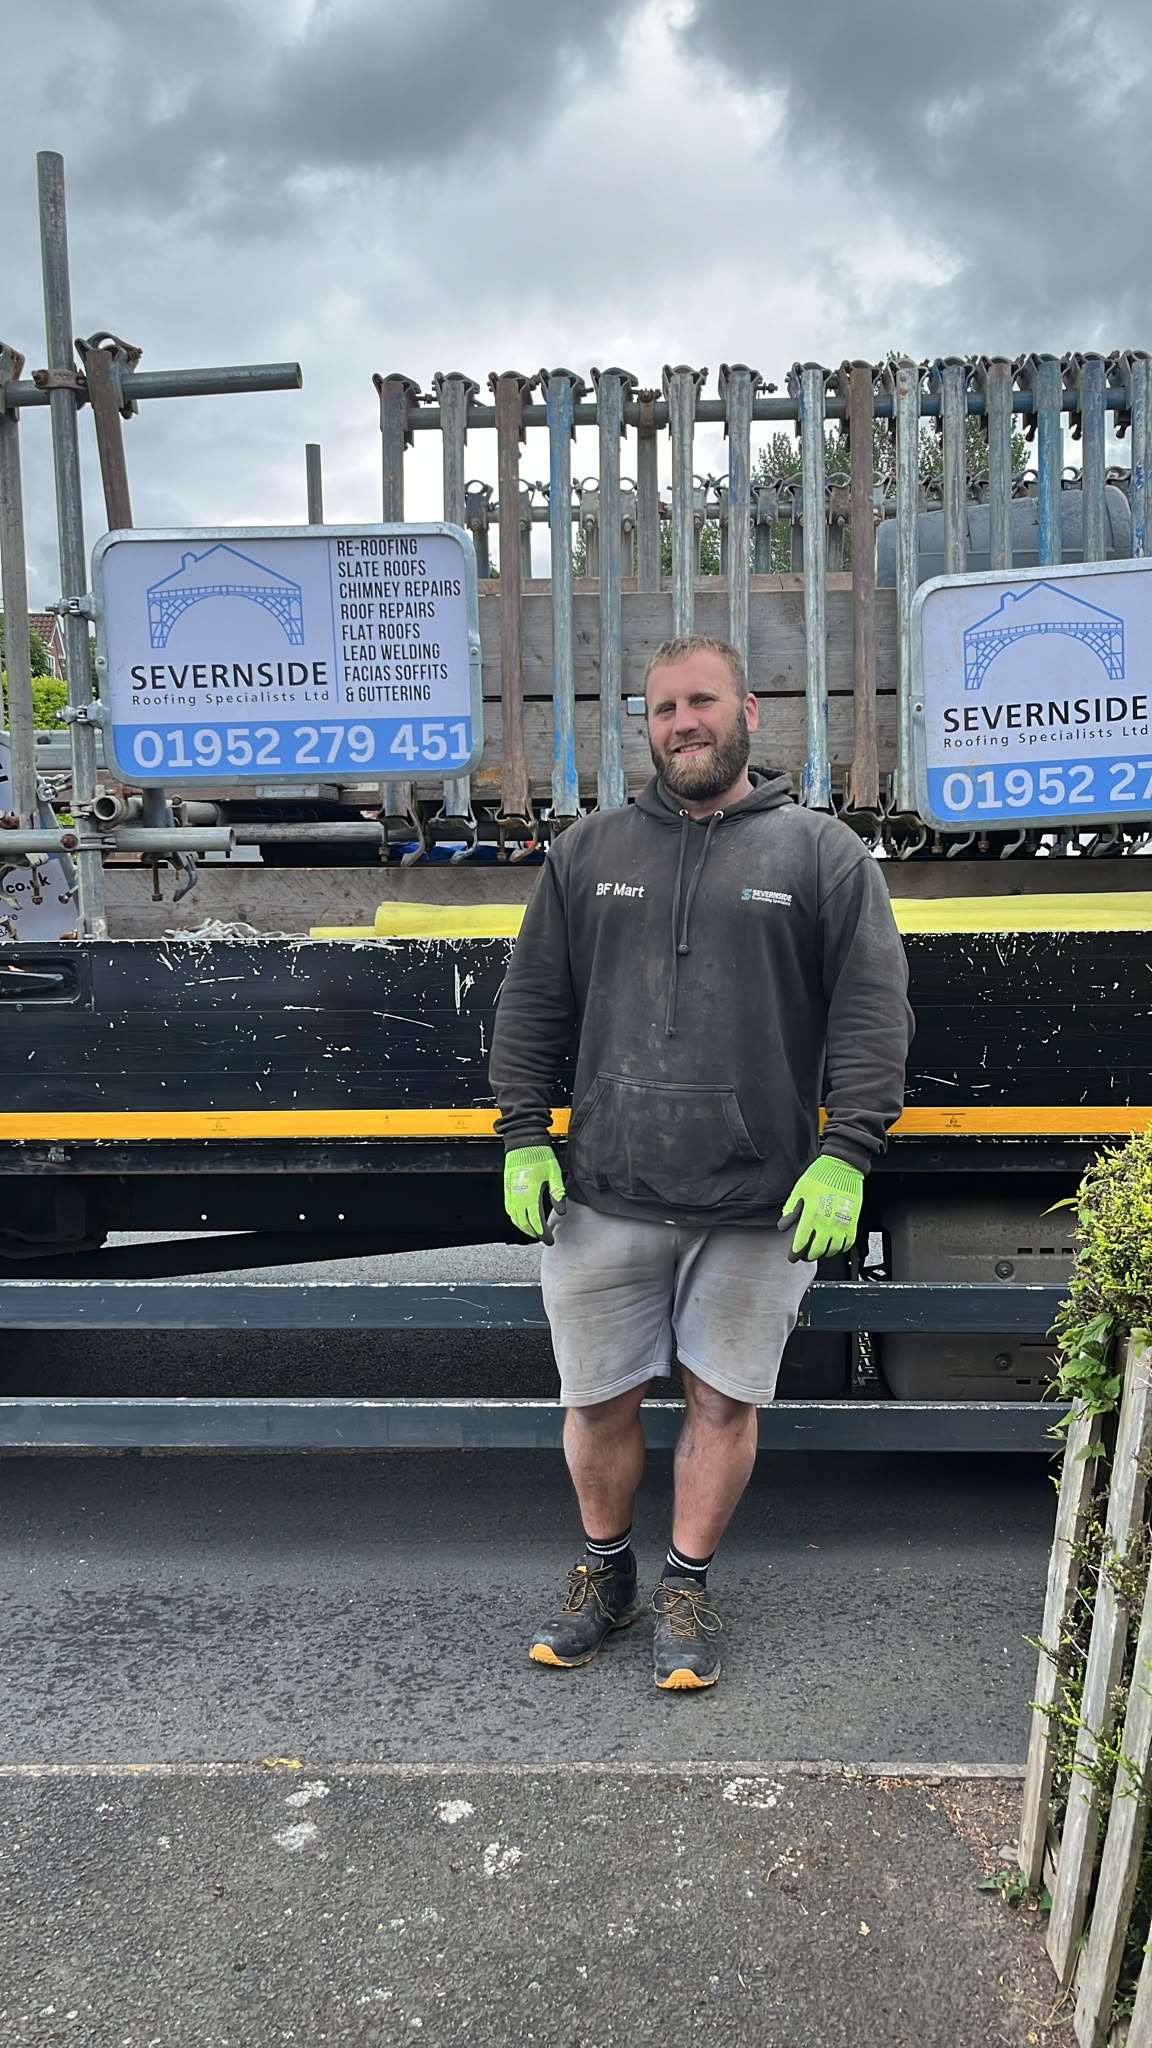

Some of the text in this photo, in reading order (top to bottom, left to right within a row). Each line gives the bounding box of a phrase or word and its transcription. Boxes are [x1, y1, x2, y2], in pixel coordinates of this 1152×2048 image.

[337, 539, 418, 557] RE-ROOFING
[338, 560, 426, 578] SLATE ROOFS
[340, 580, 461, 599] CHIMNEY REPAIRS
[341, 602, 435, 619] ROOF REPAIRS
[342, 623, 421, 641] FLAT ROOFS
[343, 643, 440, 661] LEAD WELDING
[131, 661, 328, 690] SEVERNSIDE
[344, 664, 448, 682] FACIAS SOFFITS
[133, 691, 329, 706] Roofing Specialists Ltd
[345, 685, 431, 702] & GUTTERING
[943, 695, 1148, 733] SEVERNSIDE
[133, 723, 471, 768] 01952 279 451
[944, 725, 1148, 748] Roofing Specialists Ltd
[943, 765, 1095, 811] 01952
[596, 882, 645, 898] BF Mart
